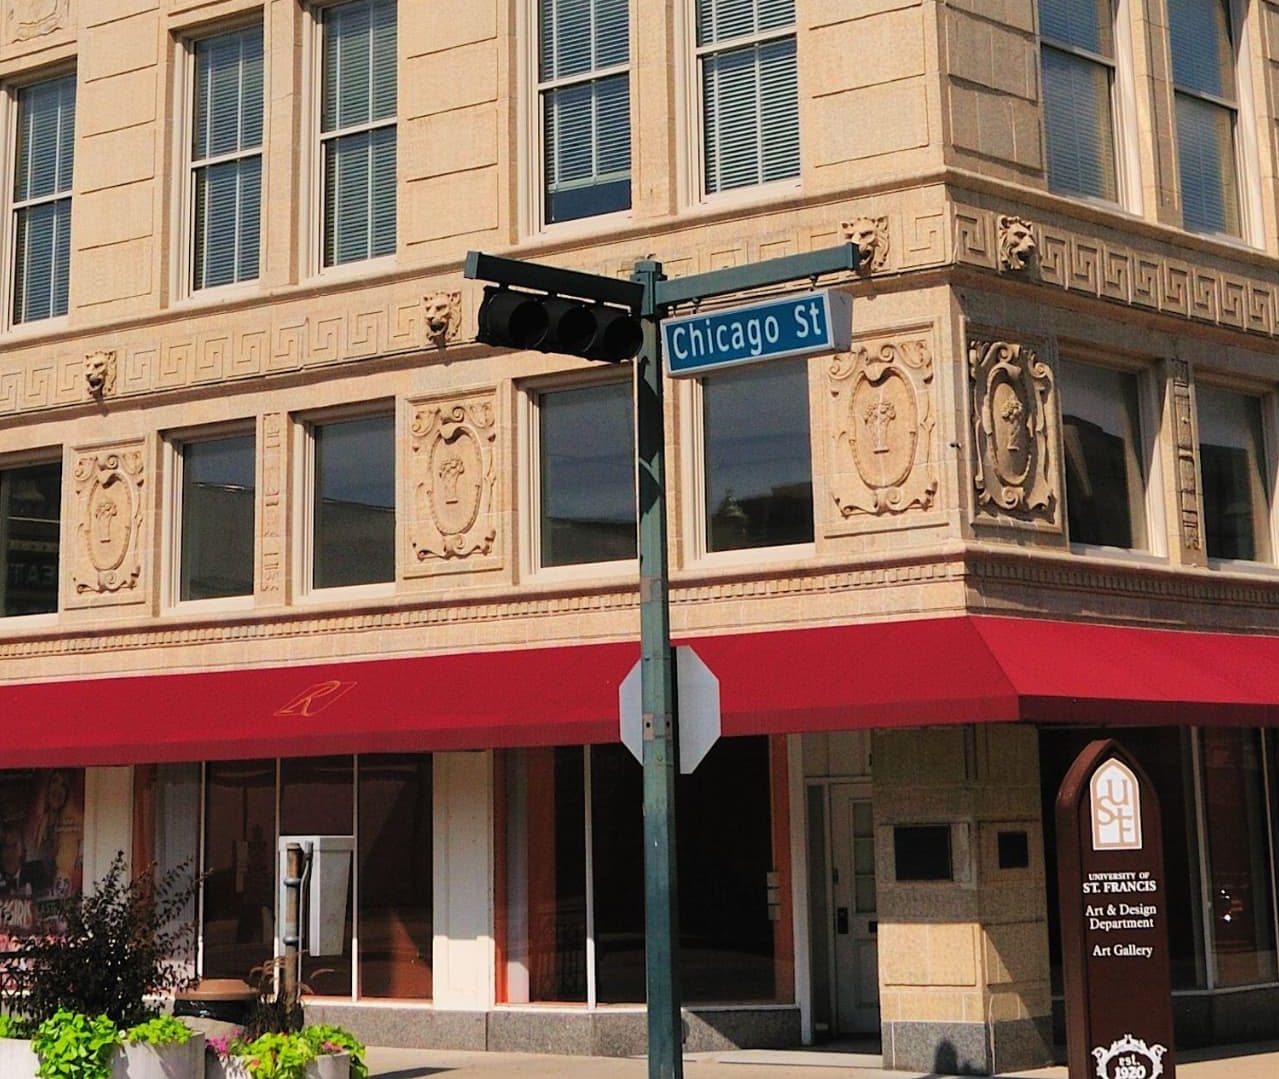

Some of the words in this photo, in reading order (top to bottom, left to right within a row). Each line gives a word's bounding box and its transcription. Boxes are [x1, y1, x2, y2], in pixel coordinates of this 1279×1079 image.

[673, 316, 779, 359] Chicago
[794, 301, 822, 338] St
[1088, 872, 1136, 881] UNIVERSITY
[1139, 871, 1150, 879] OF
[1082, 881, 1101, 894] ST.
[1103, 880, 1157, 893] FRANCIS
[1085, 904, 1104, 917] Art
[1106, 903, 1117, 916] &
[1119, 903, 1157, 917] Design
[1089, 917, 1154, 932] Department
[1092, 944, 1111, 956] Art
[1113, 943, 1153, 958] Gallery
[1114, 1065, 1147, 1079] 1920
